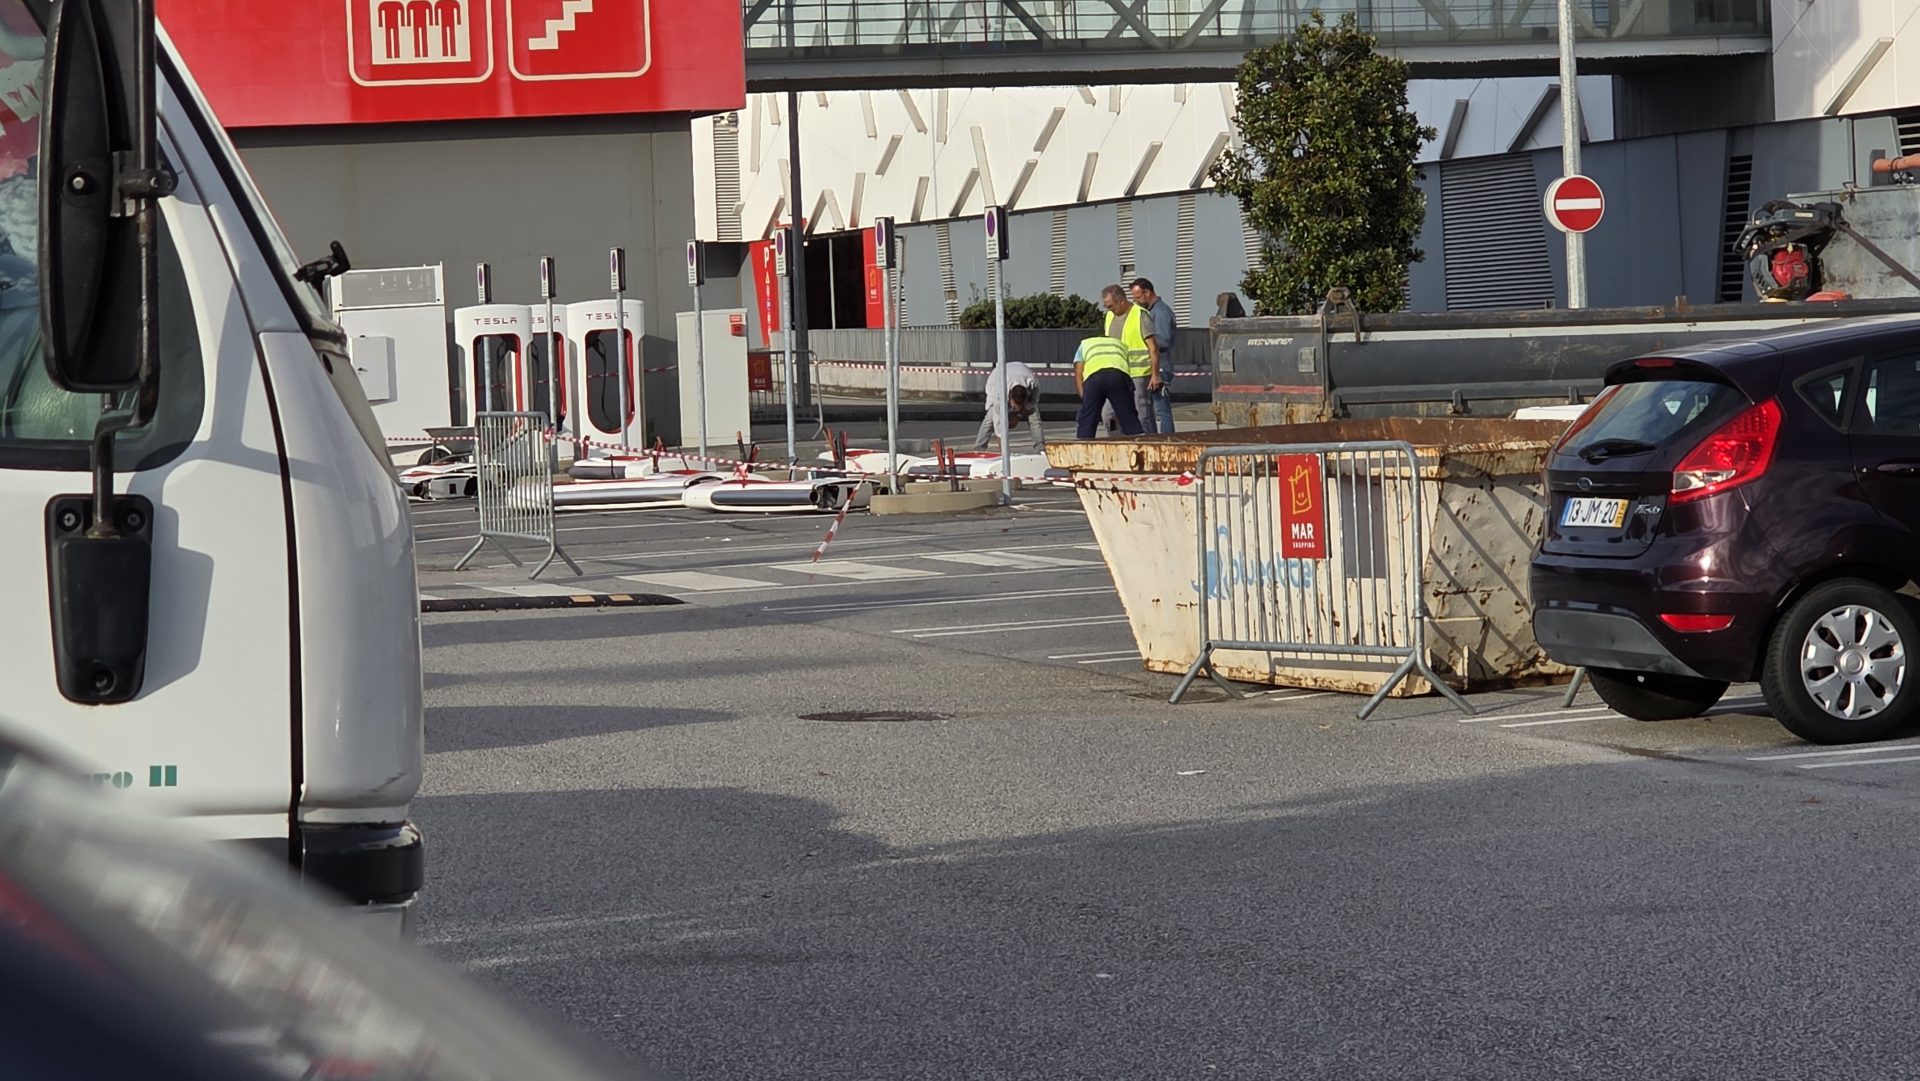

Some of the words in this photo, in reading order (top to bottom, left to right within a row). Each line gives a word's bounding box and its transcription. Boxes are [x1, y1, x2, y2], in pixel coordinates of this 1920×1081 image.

[531, 315, 561, 324] ESA
[586, 312, 628, 320] TESLA
[474, 317, 517, 325] TESLA
[1291, 522, 1314, 540] MAR
[1292, 541, 1316, 549] SHOPPING
[149, 765, 177, 787] II
